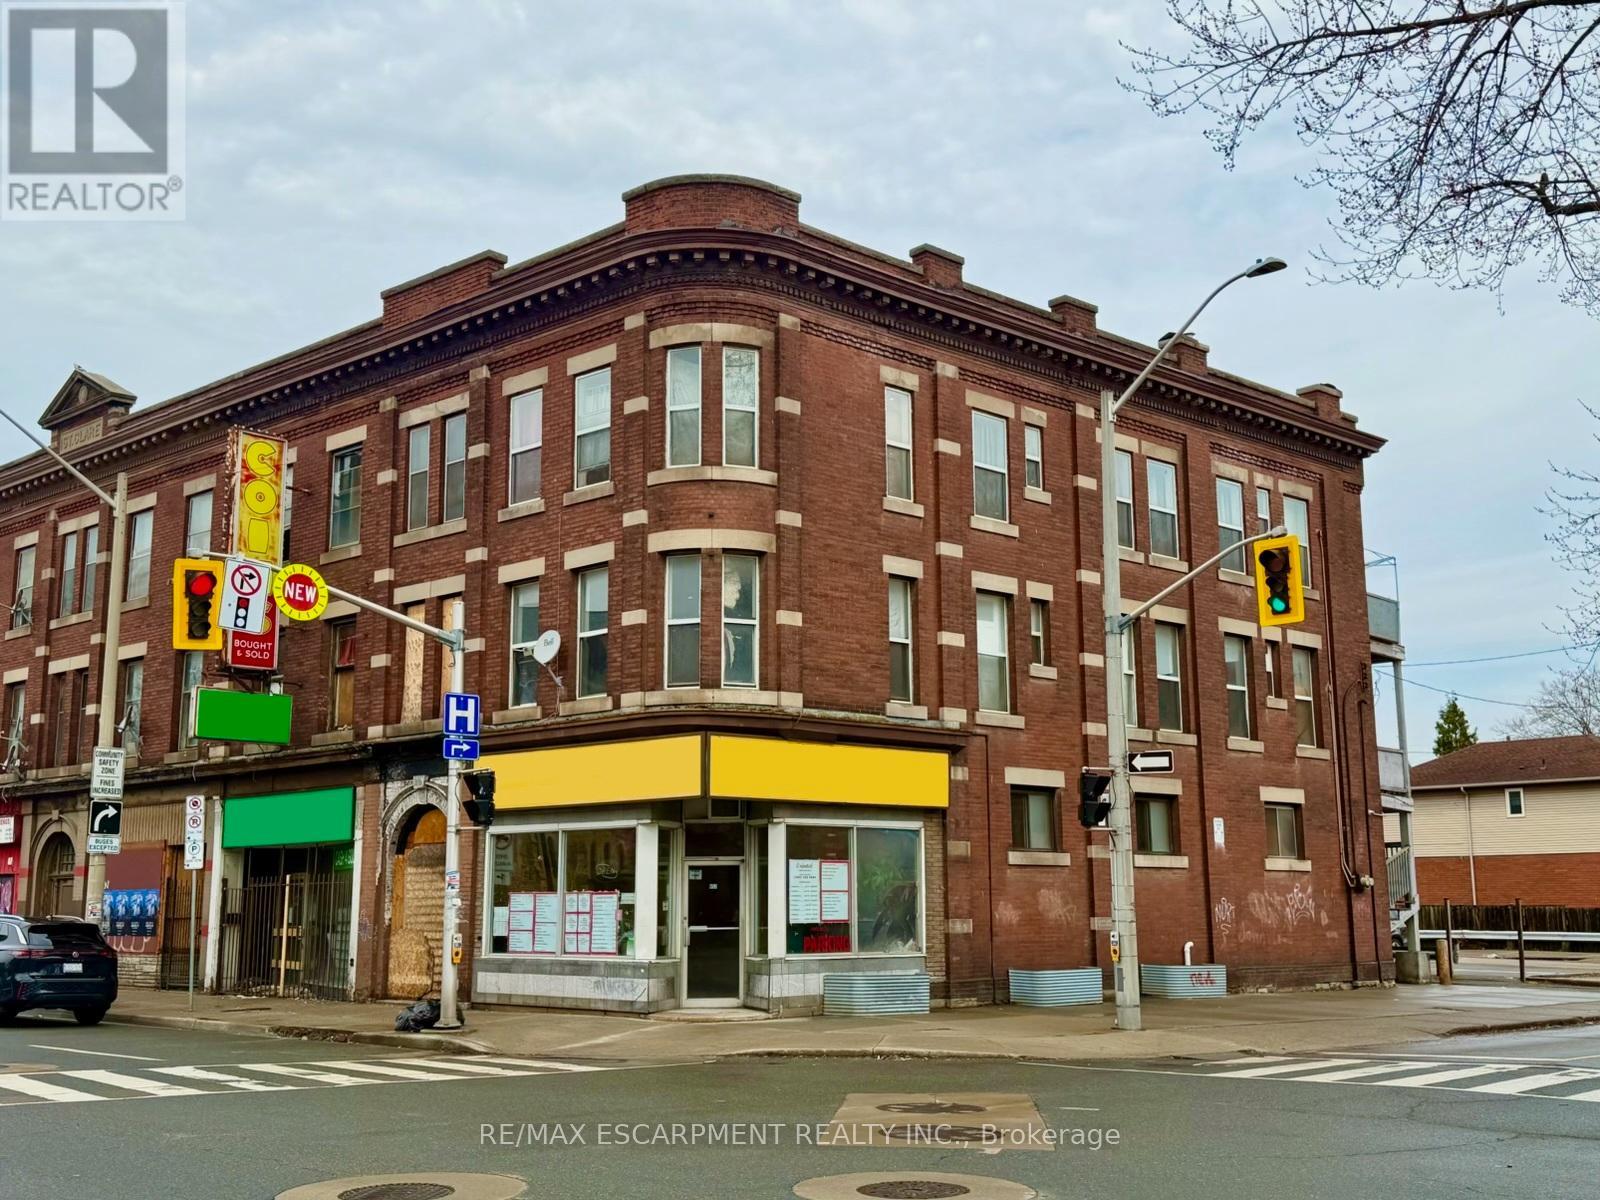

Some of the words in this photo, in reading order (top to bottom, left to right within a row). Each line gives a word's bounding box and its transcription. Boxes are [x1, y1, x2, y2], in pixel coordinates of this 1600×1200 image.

[284, 580, 317, 603] NEW
[234, 639, 272, 650] BOUGHT
[236, 649, 243, 657] &
[245, 650, 270, 660] SOLD
[448, 697, 475, 732] H
[95, 750, 123, 759] COMMUNITY
[101, 767, 115, 775] ZONE
[93, 787, 121, 795] INCREASED
